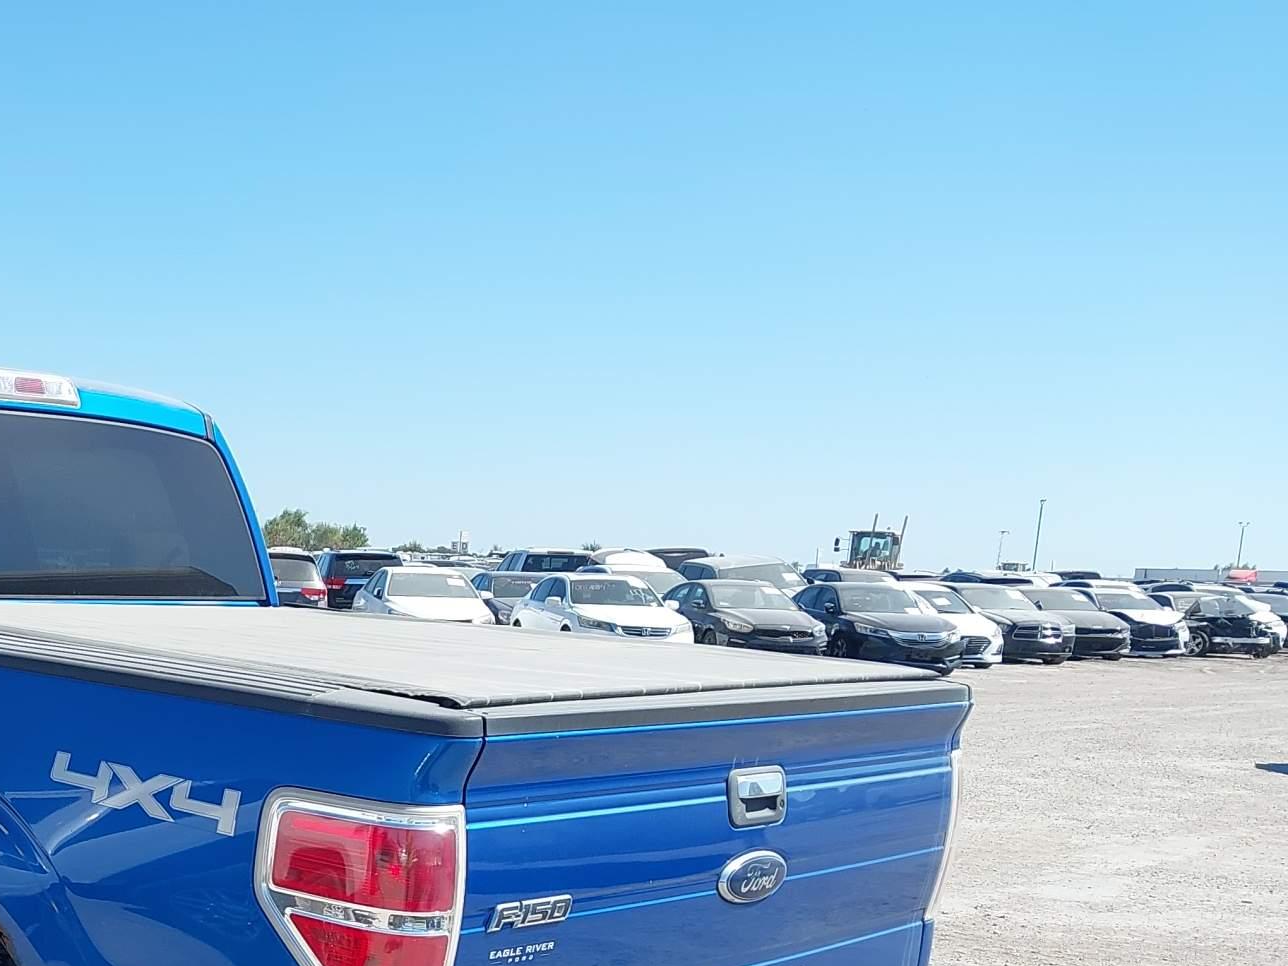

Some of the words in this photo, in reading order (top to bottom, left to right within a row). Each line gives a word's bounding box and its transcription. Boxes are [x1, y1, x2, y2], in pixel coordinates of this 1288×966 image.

[741, 862, 779, 893] Ford
[487, 894, 573, 934] F-150
[489, 946, 523, 960] EAGLE
[525, 941, 555, 954] RIVER
